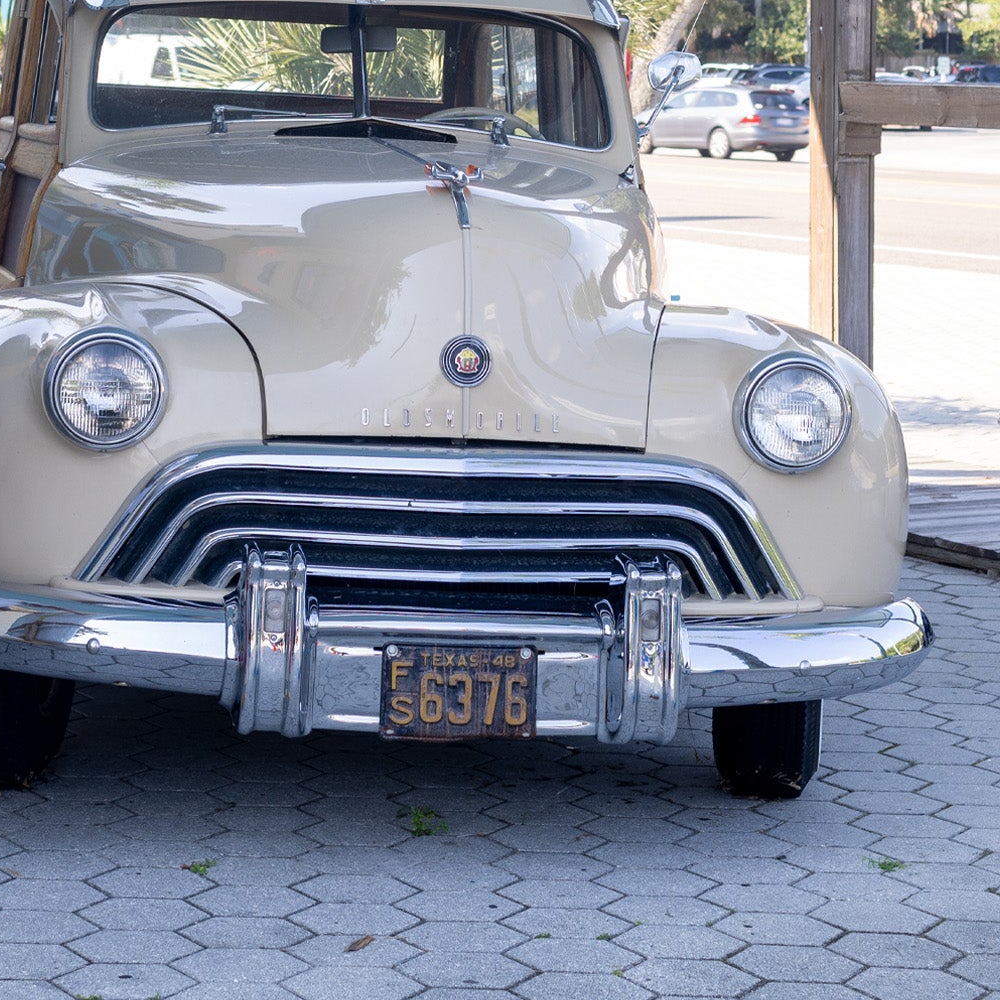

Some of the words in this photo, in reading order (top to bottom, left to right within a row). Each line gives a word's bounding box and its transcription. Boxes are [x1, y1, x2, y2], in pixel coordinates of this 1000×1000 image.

[361, 407, 560, 433] OLDSMOBILE
[391, 660, 414, 690] F
[388, 696, 414, 725] S
[420, 672, 528, 726] 6376
